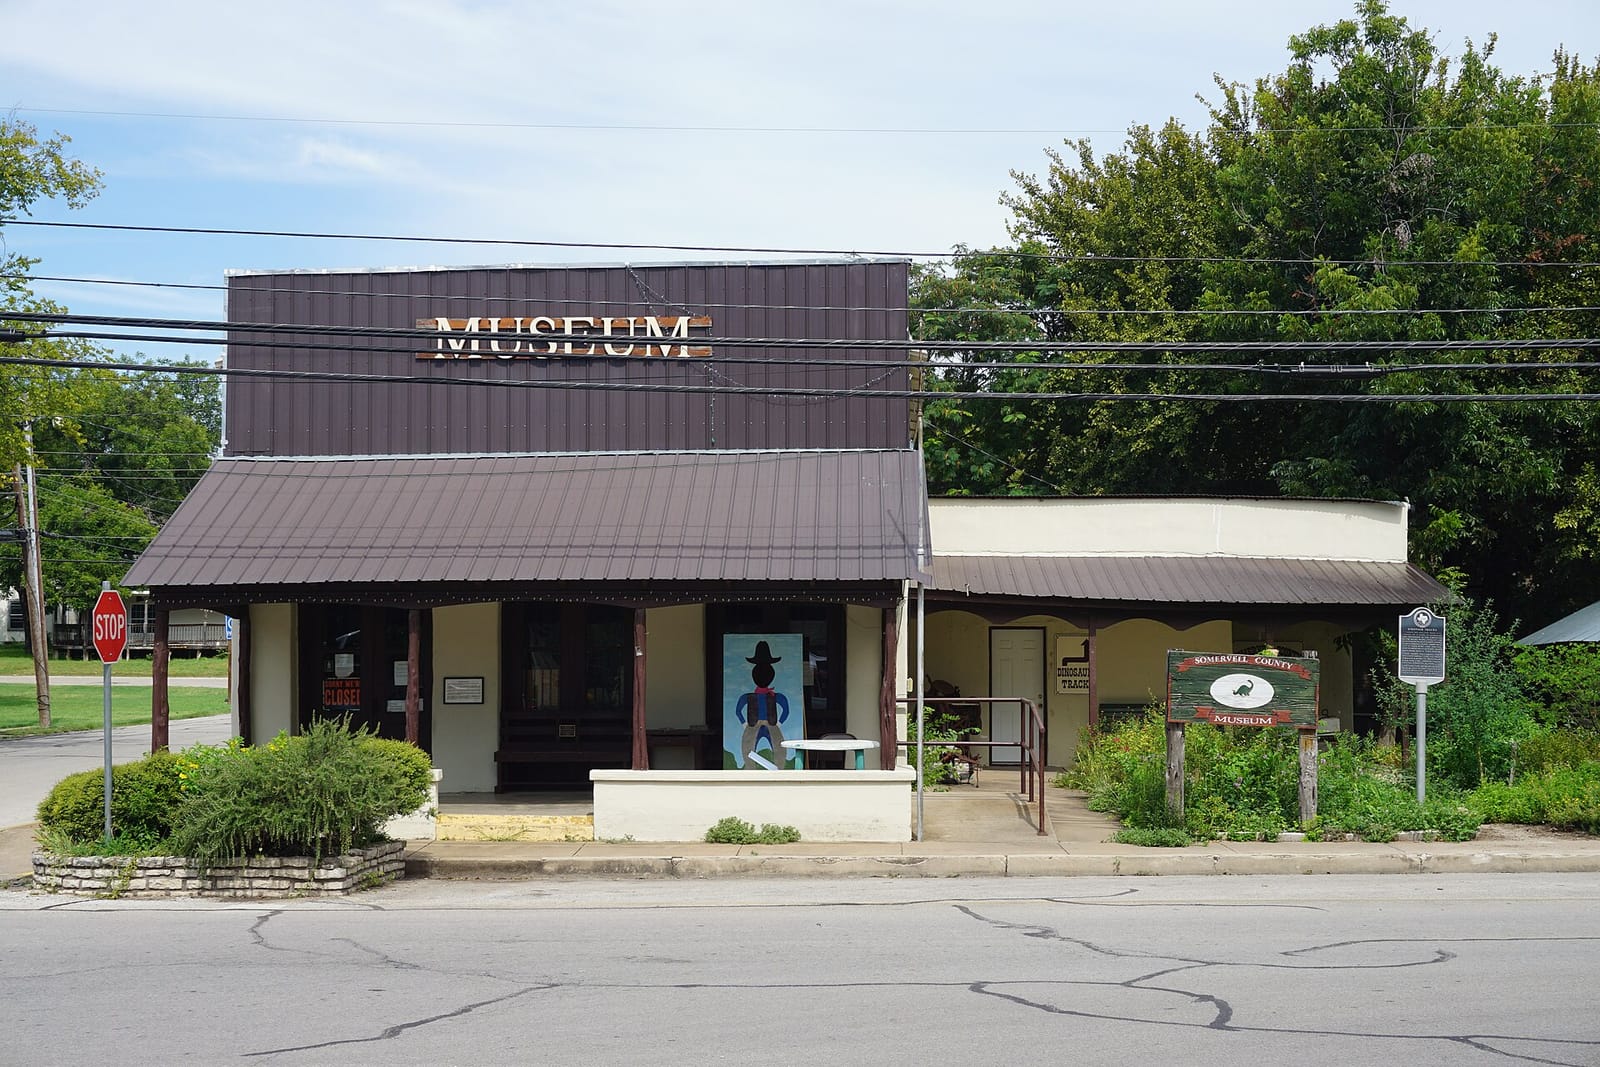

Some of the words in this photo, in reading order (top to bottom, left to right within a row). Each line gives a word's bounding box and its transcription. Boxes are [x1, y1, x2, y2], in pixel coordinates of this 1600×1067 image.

[434, 316, 692, 359] MUSEUM
[96, 613, 125, 640] STOP
[1194, 655, 1249, 665] SOMERVELL
[1254, 656, 1294, 670] COUNTY
[1213, 715, 1273, 725] MUSEUM
